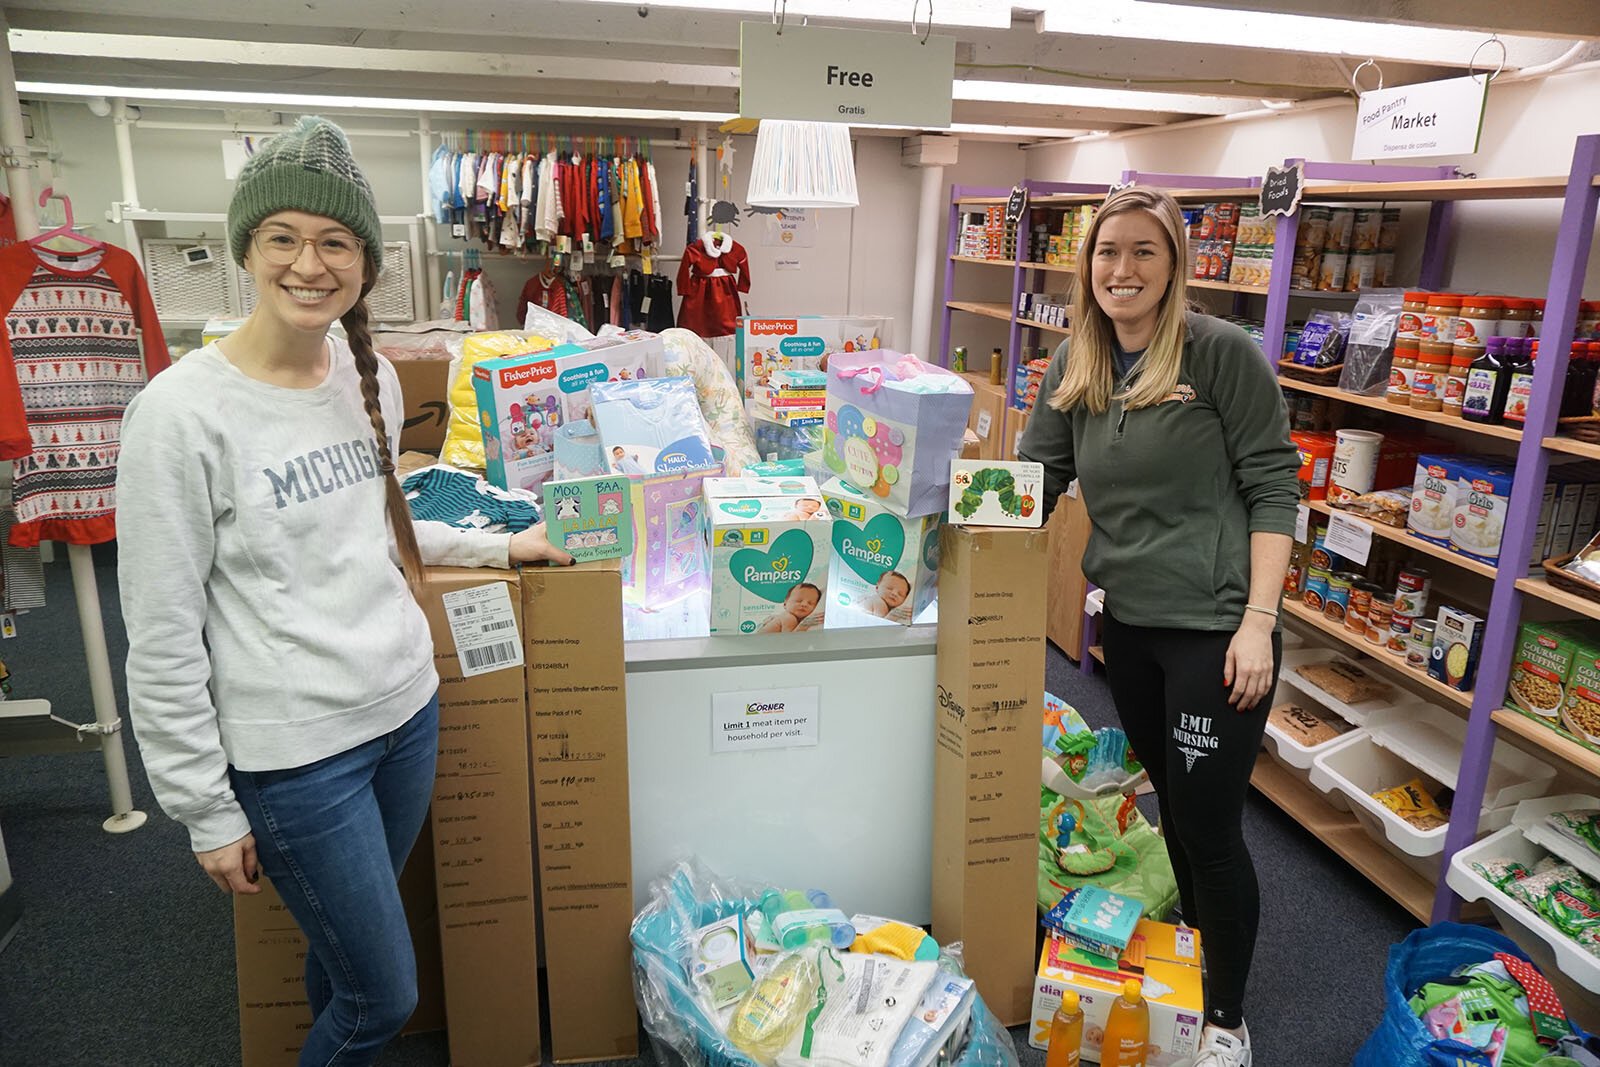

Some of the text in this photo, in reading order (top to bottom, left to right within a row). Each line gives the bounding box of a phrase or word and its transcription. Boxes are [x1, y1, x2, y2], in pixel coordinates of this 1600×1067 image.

[827, 65, 874, 88] Free
[837, 104, 866, 115] Gratis
[1362, 96, 1408, 125] Food Pantry
[1391, 111, 1438, 130] Market
[1408, 142, 1416, 150] de
[1269, 176, 1287, 188] Dried
[1267, 187, 1290, 200] Foods
[753, 322, 794, 331] Fisher-Price
[504, 365, 554, 382] Fisher-Price
[562, 371, 589, 383] Soothing
[594, 368, 604, 376] fun
[668, 456, 687, 464] HALO
[1333, 460, 1347, 474] ATS
[1423, 477, 1448, 494] Grits
[1467, 490, 1494, 510] Grits
[563, 515, 618, 532] LA LA LA!
[570, 546, 623, 558] Sandra Boynton
[842, 538, 893, 567] Pampers
[744, 565, 802, 584] Pampers
[840, 576, 868, 588] sensitive
[1523, 641, 1568, 665] GOURMET
[1521, 650, 1566, 674] STUFFING
[748, 702, 785, 712] CORNER
[723, 722, 744, 730] Limit
[752, 720, 772, 728] meat
[774, 718, 792, 726] item
[794, 717, 807, 726] per
[1180, 712, 1212, 734] EMU
[727, 731, 768, 742] household
[770, 731, 783, 739] per
[1172, 727, 1219, 749] NURSING
[541, 800, 556, 808] MADE
[1039, 984, 1094, 1004] diars
[1180, 1027, 1190, 1036] N
